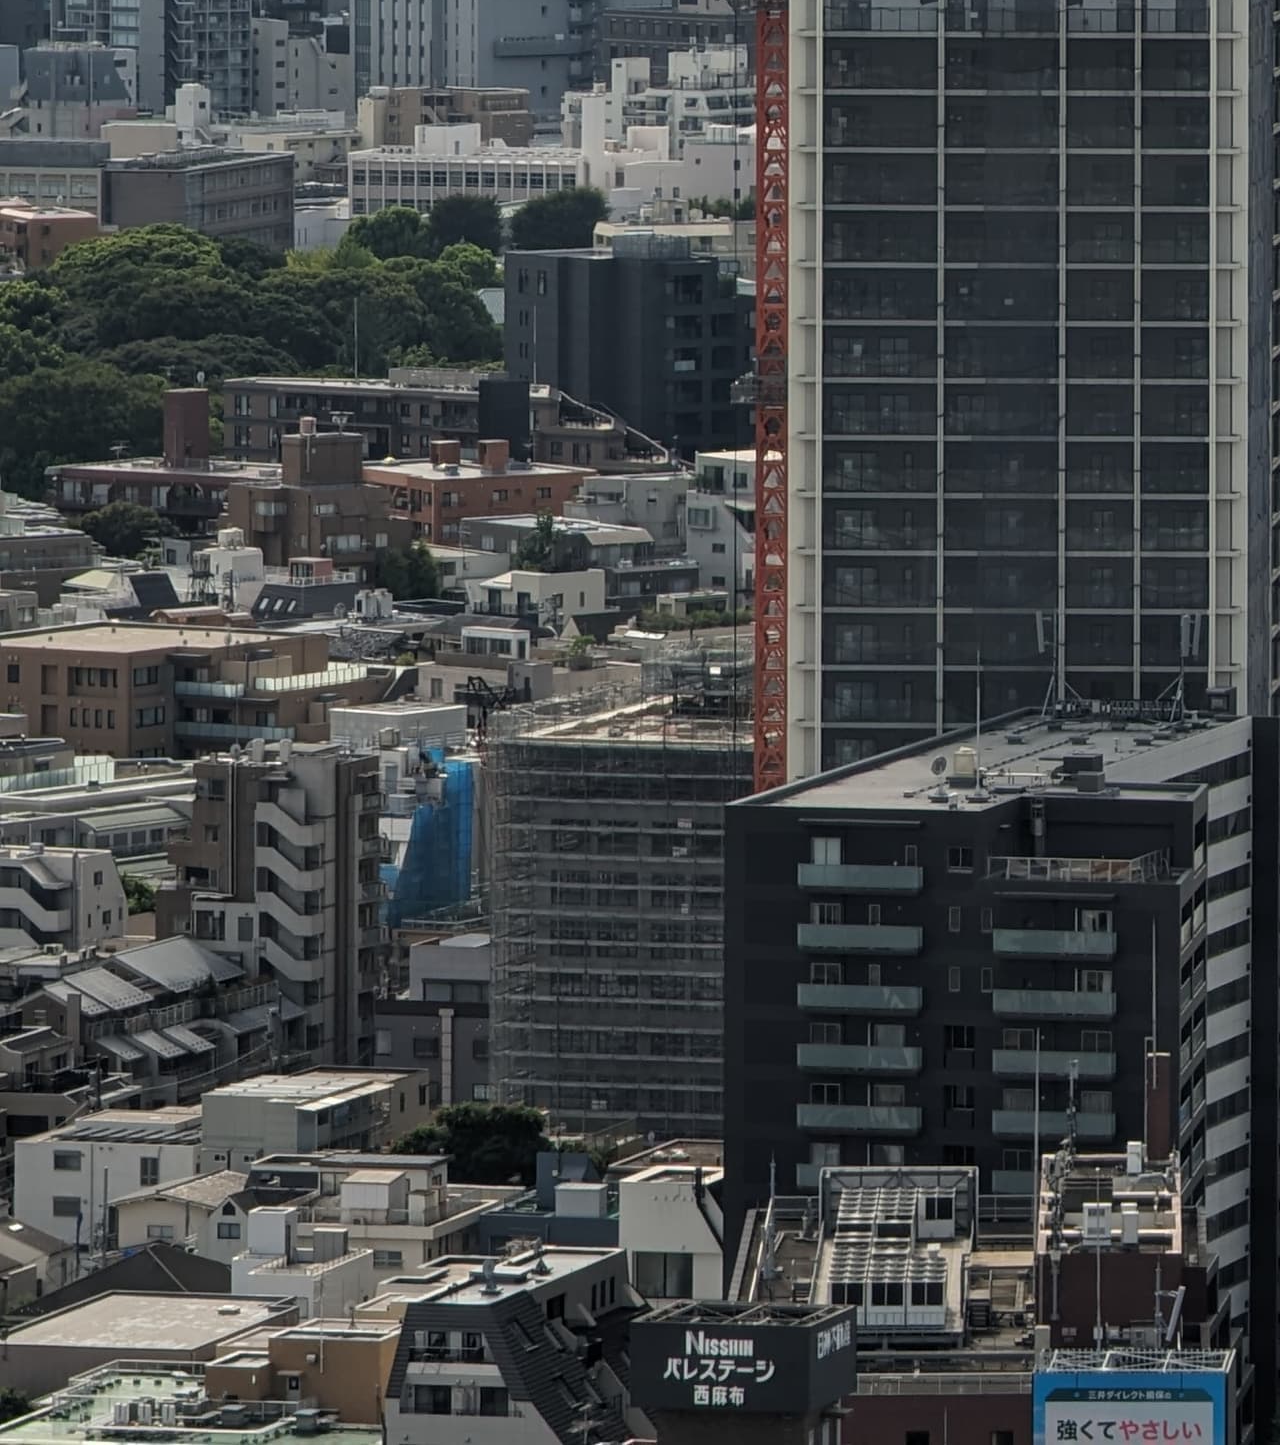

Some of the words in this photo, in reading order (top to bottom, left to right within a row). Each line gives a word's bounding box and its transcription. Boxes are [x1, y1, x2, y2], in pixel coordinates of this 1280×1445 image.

[663, 1357, 775, 1383] パレステージ
[693, 1384, 745, 1406] 西麻布
[1056, 1420, 1202, 1441] 強くてやさしい
